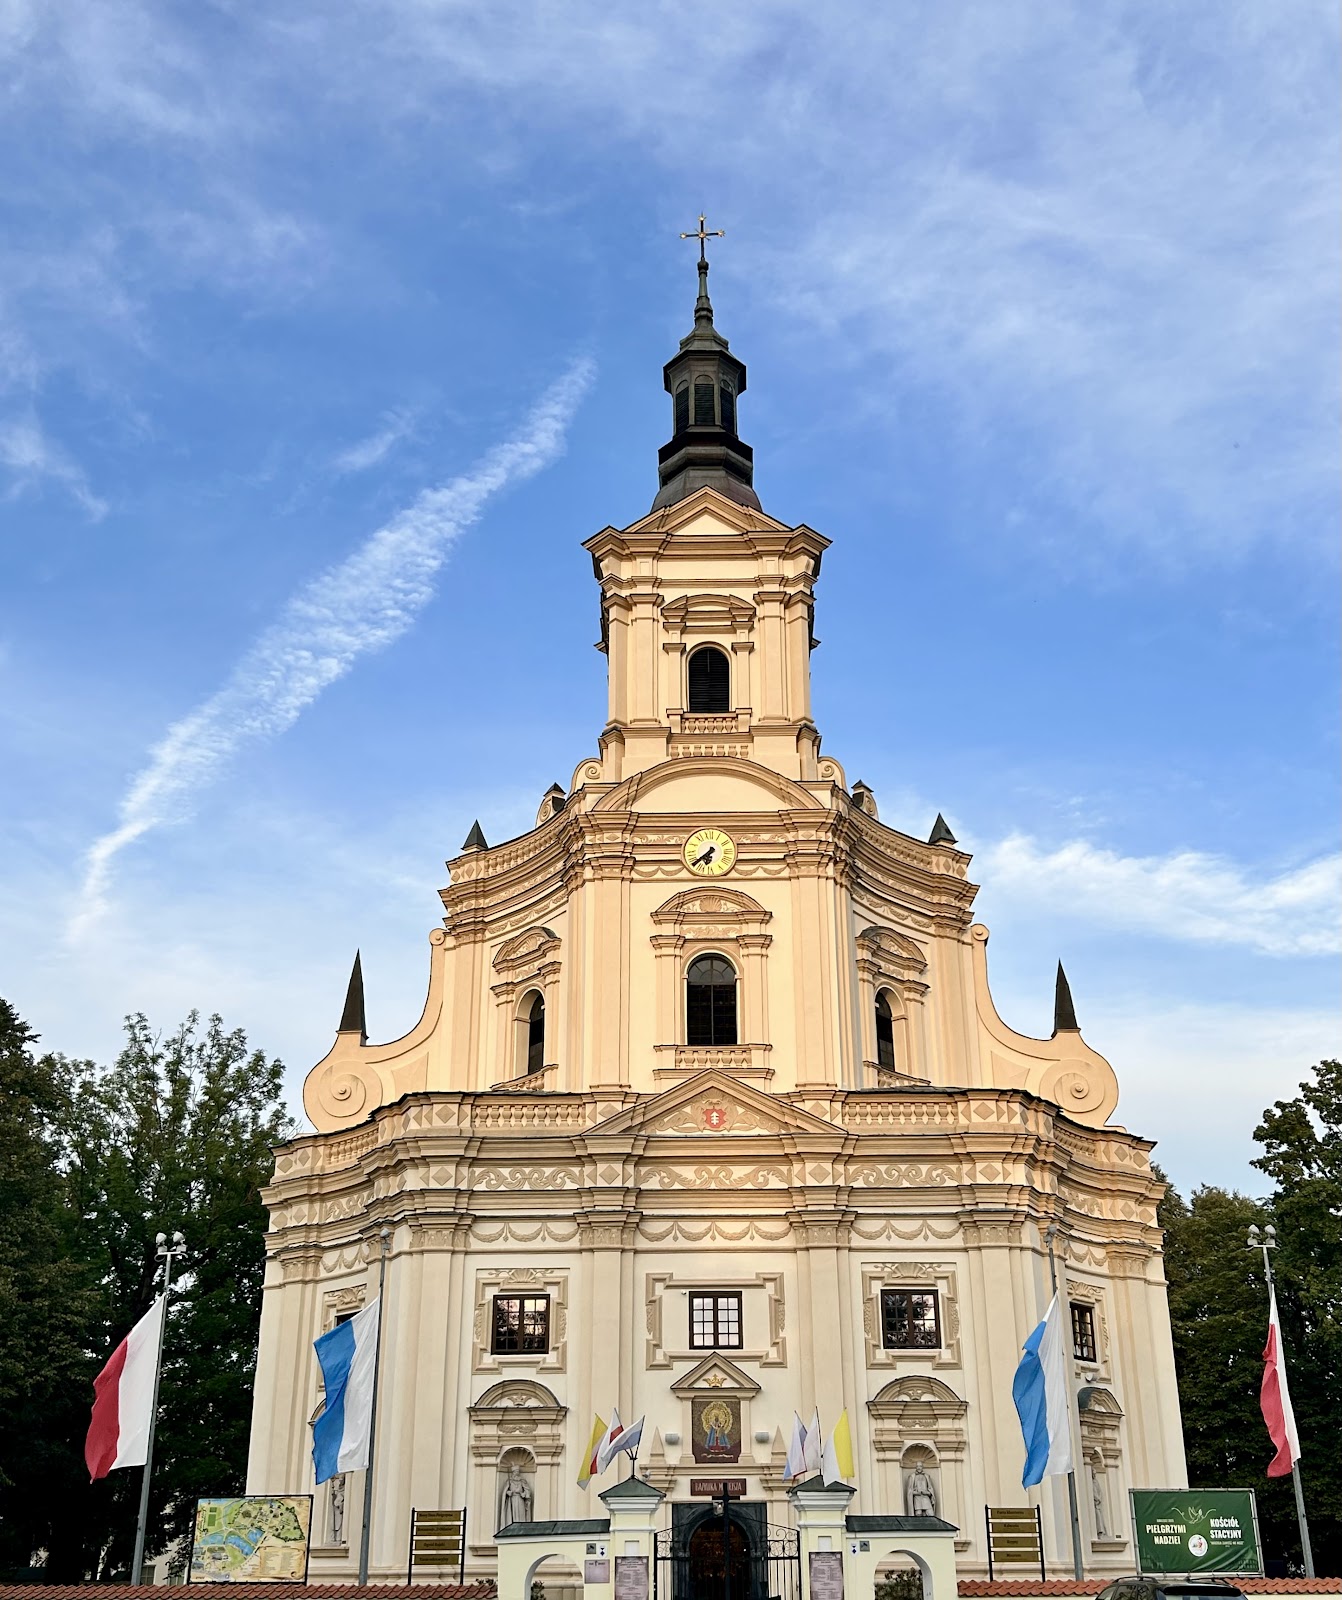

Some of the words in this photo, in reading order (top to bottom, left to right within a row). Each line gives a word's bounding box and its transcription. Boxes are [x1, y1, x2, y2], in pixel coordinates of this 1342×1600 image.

[1210, 1516, 1239, 1528] KOŚCIÓŁ
[1146, 1524, 1186, 1534] PIELGRZYMI
[1210, 1530, 1242, 1539] STACYJNY
[1154, 1535, 1181, 1544] NADZIEI
